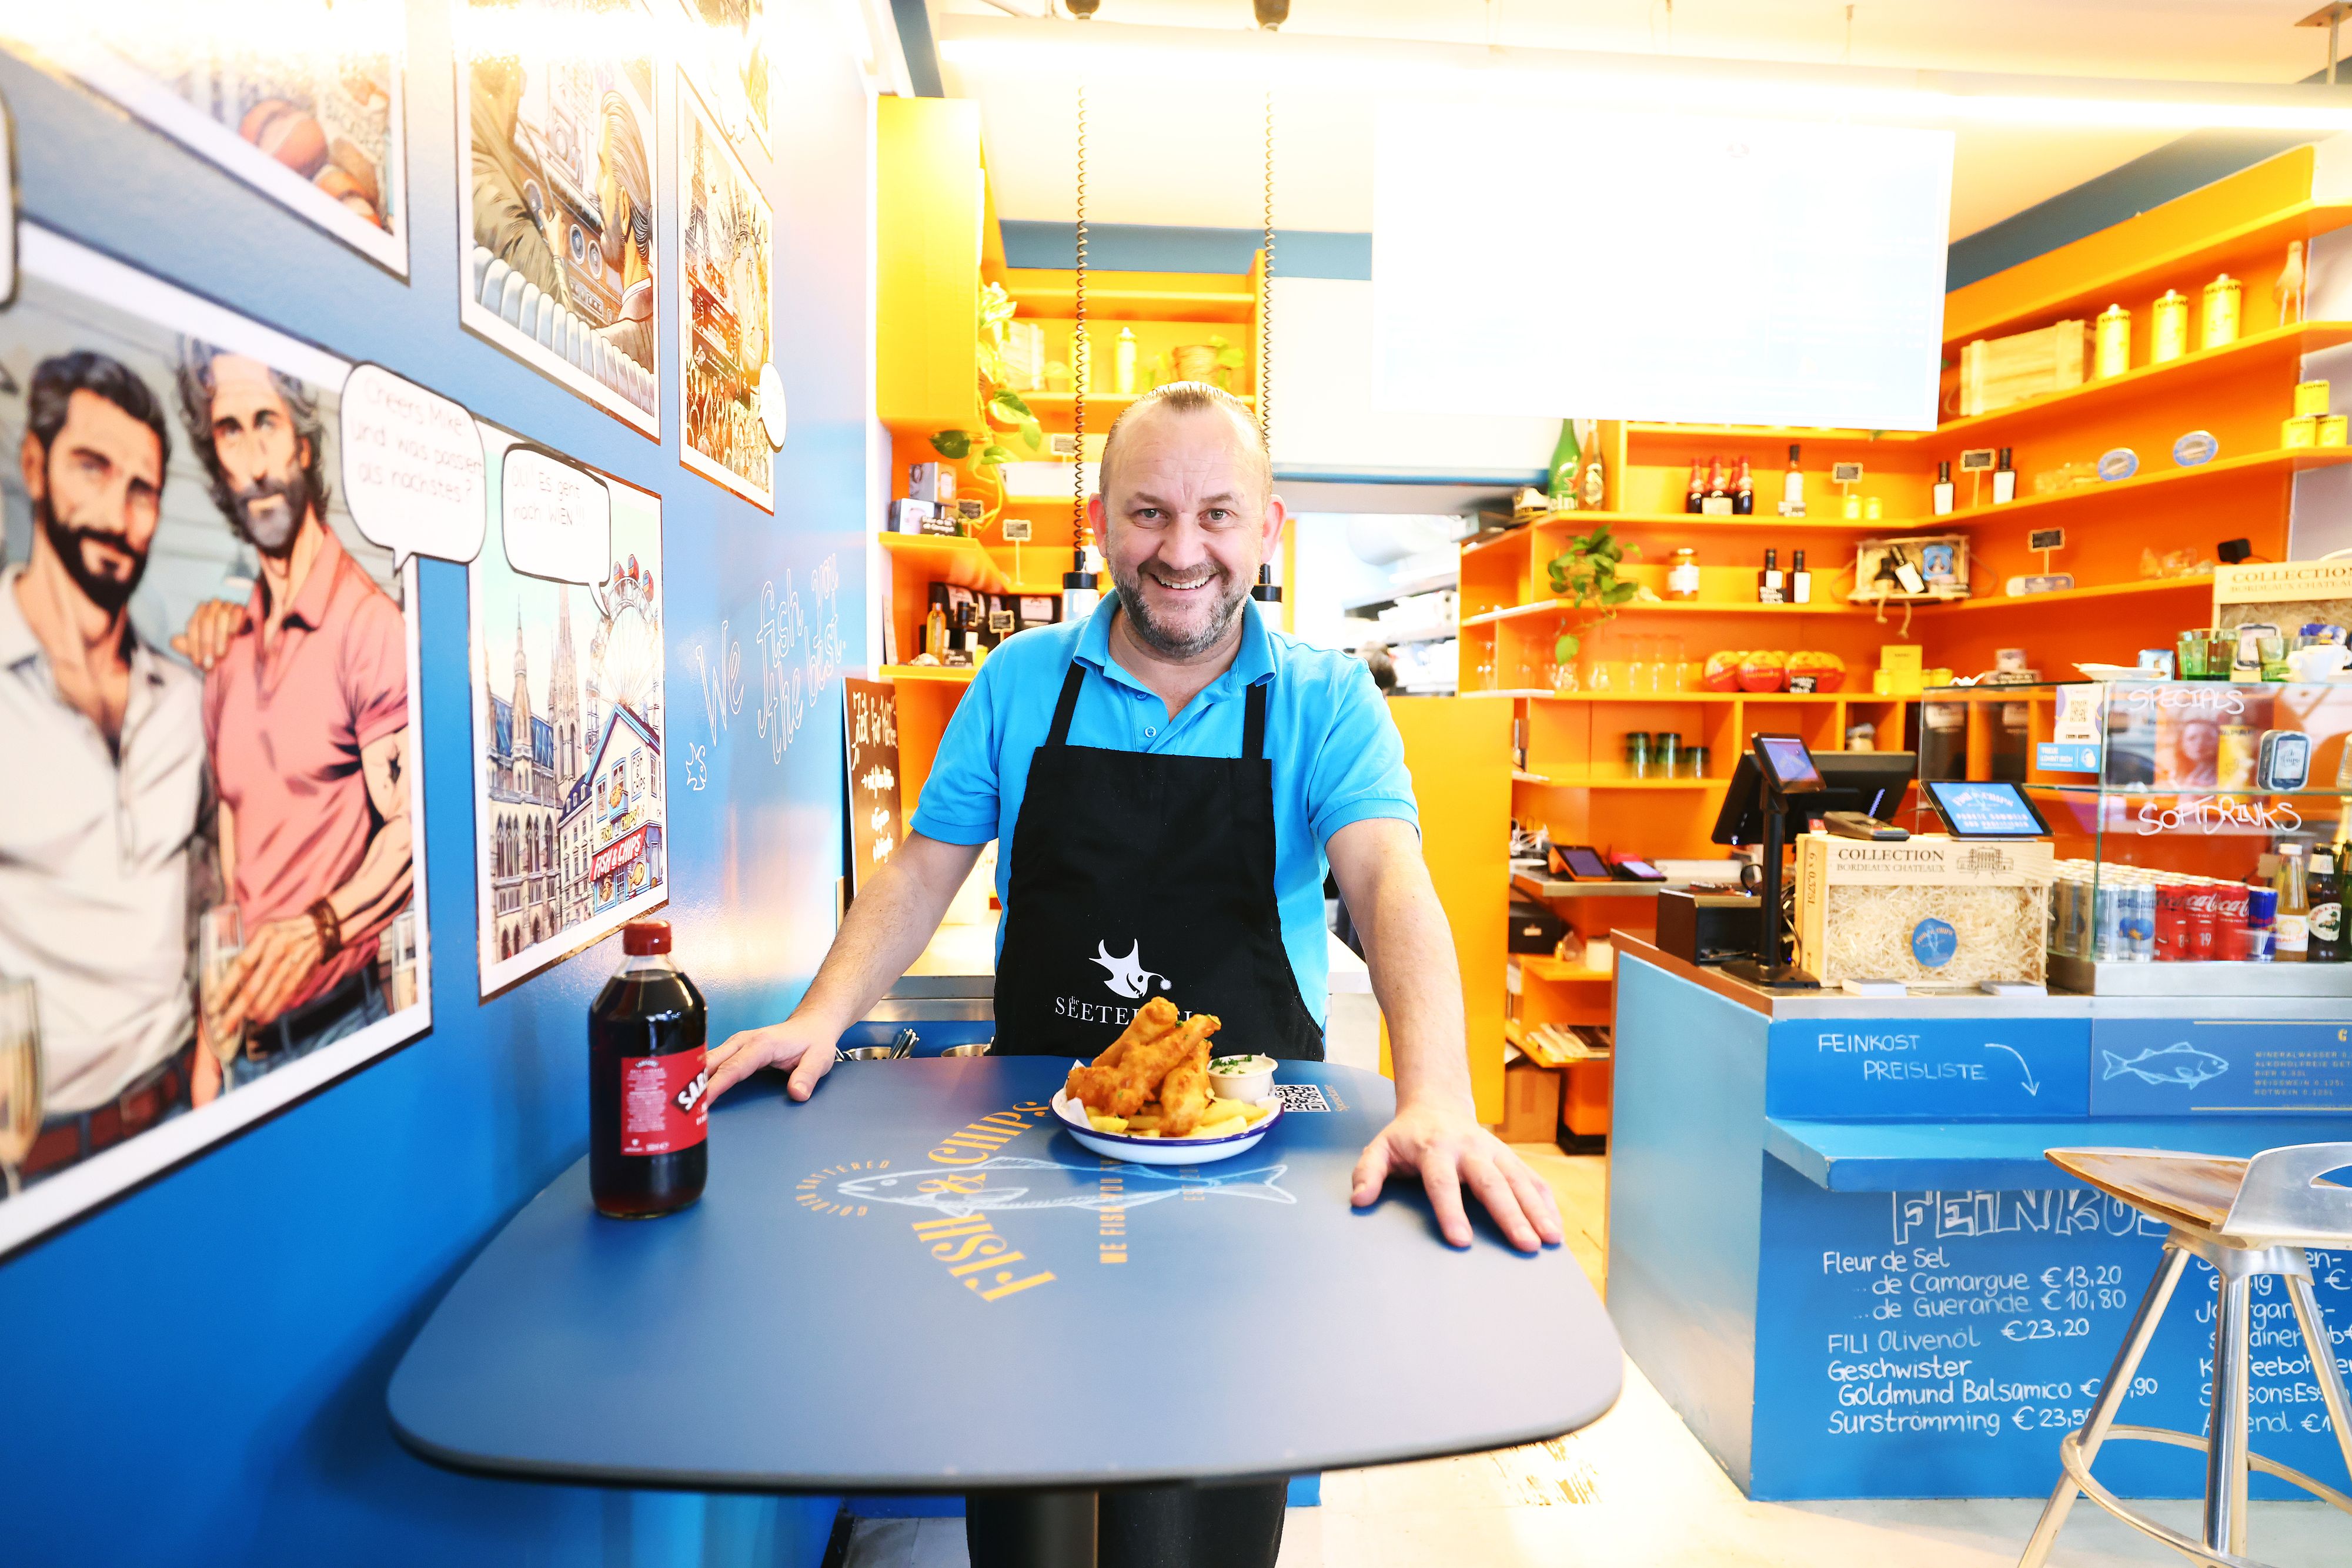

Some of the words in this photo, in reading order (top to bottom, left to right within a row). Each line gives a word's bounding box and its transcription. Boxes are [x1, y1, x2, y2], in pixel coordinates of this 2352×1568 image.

[539, 472, 552, 493] Es
[557, 480, 581, 502] geht
[513, 500, 542, 523] nach
[696, 619, 745, 747] We
[756, 568, 804, 739] fish
[767, 661, 804, 765] the
[2127, 687, 2245, 715] SPECIALS
[632, 754, 644, 770] FISH
[632, 777, 646, 794] CHIPS
[620, 809, 638, 832] CHIPS
[594, 848, 613, 876] FISH
[617, 833, 642, 866] CHIPS
[1838, 848, 1945, 862] COLLECTION
[1836, 864, 1891, 872] BORDEAUX
[1068, 996, 1080, 1006] die
[1818, 1034, 1922, 1052] FEINKOST
[1863, 1060, 1990, 1081] PREISLISTE
[928, 1101, 1051, 1165] CHIPS
[916, 1172, 987, 1195] &
[1892, 1189, 2171, 1246] FEINKO
[911, 1212, 1057, 1302] FISH
[1823, 1251, 1877, 1275] Fleur
[1881, 1250, 1909, 1272] de
[1913, 1246, 1951, 1269] Sel
[1872, 1275, 1903, 1295] de
[1910, 1271, 2031, 1298] Camargue
[1873, 1299, 1903, 1320] de
[1914, 1295, 2033, 1319] Guerande
[1828, 1332, 1869, 1355] FILI
[1827, 1356, 1973, 1382] Geschwister
[1838, 1382, 1955, 1407] Goldmund
[1963, 1378, 2073, 1405] Balsamico
